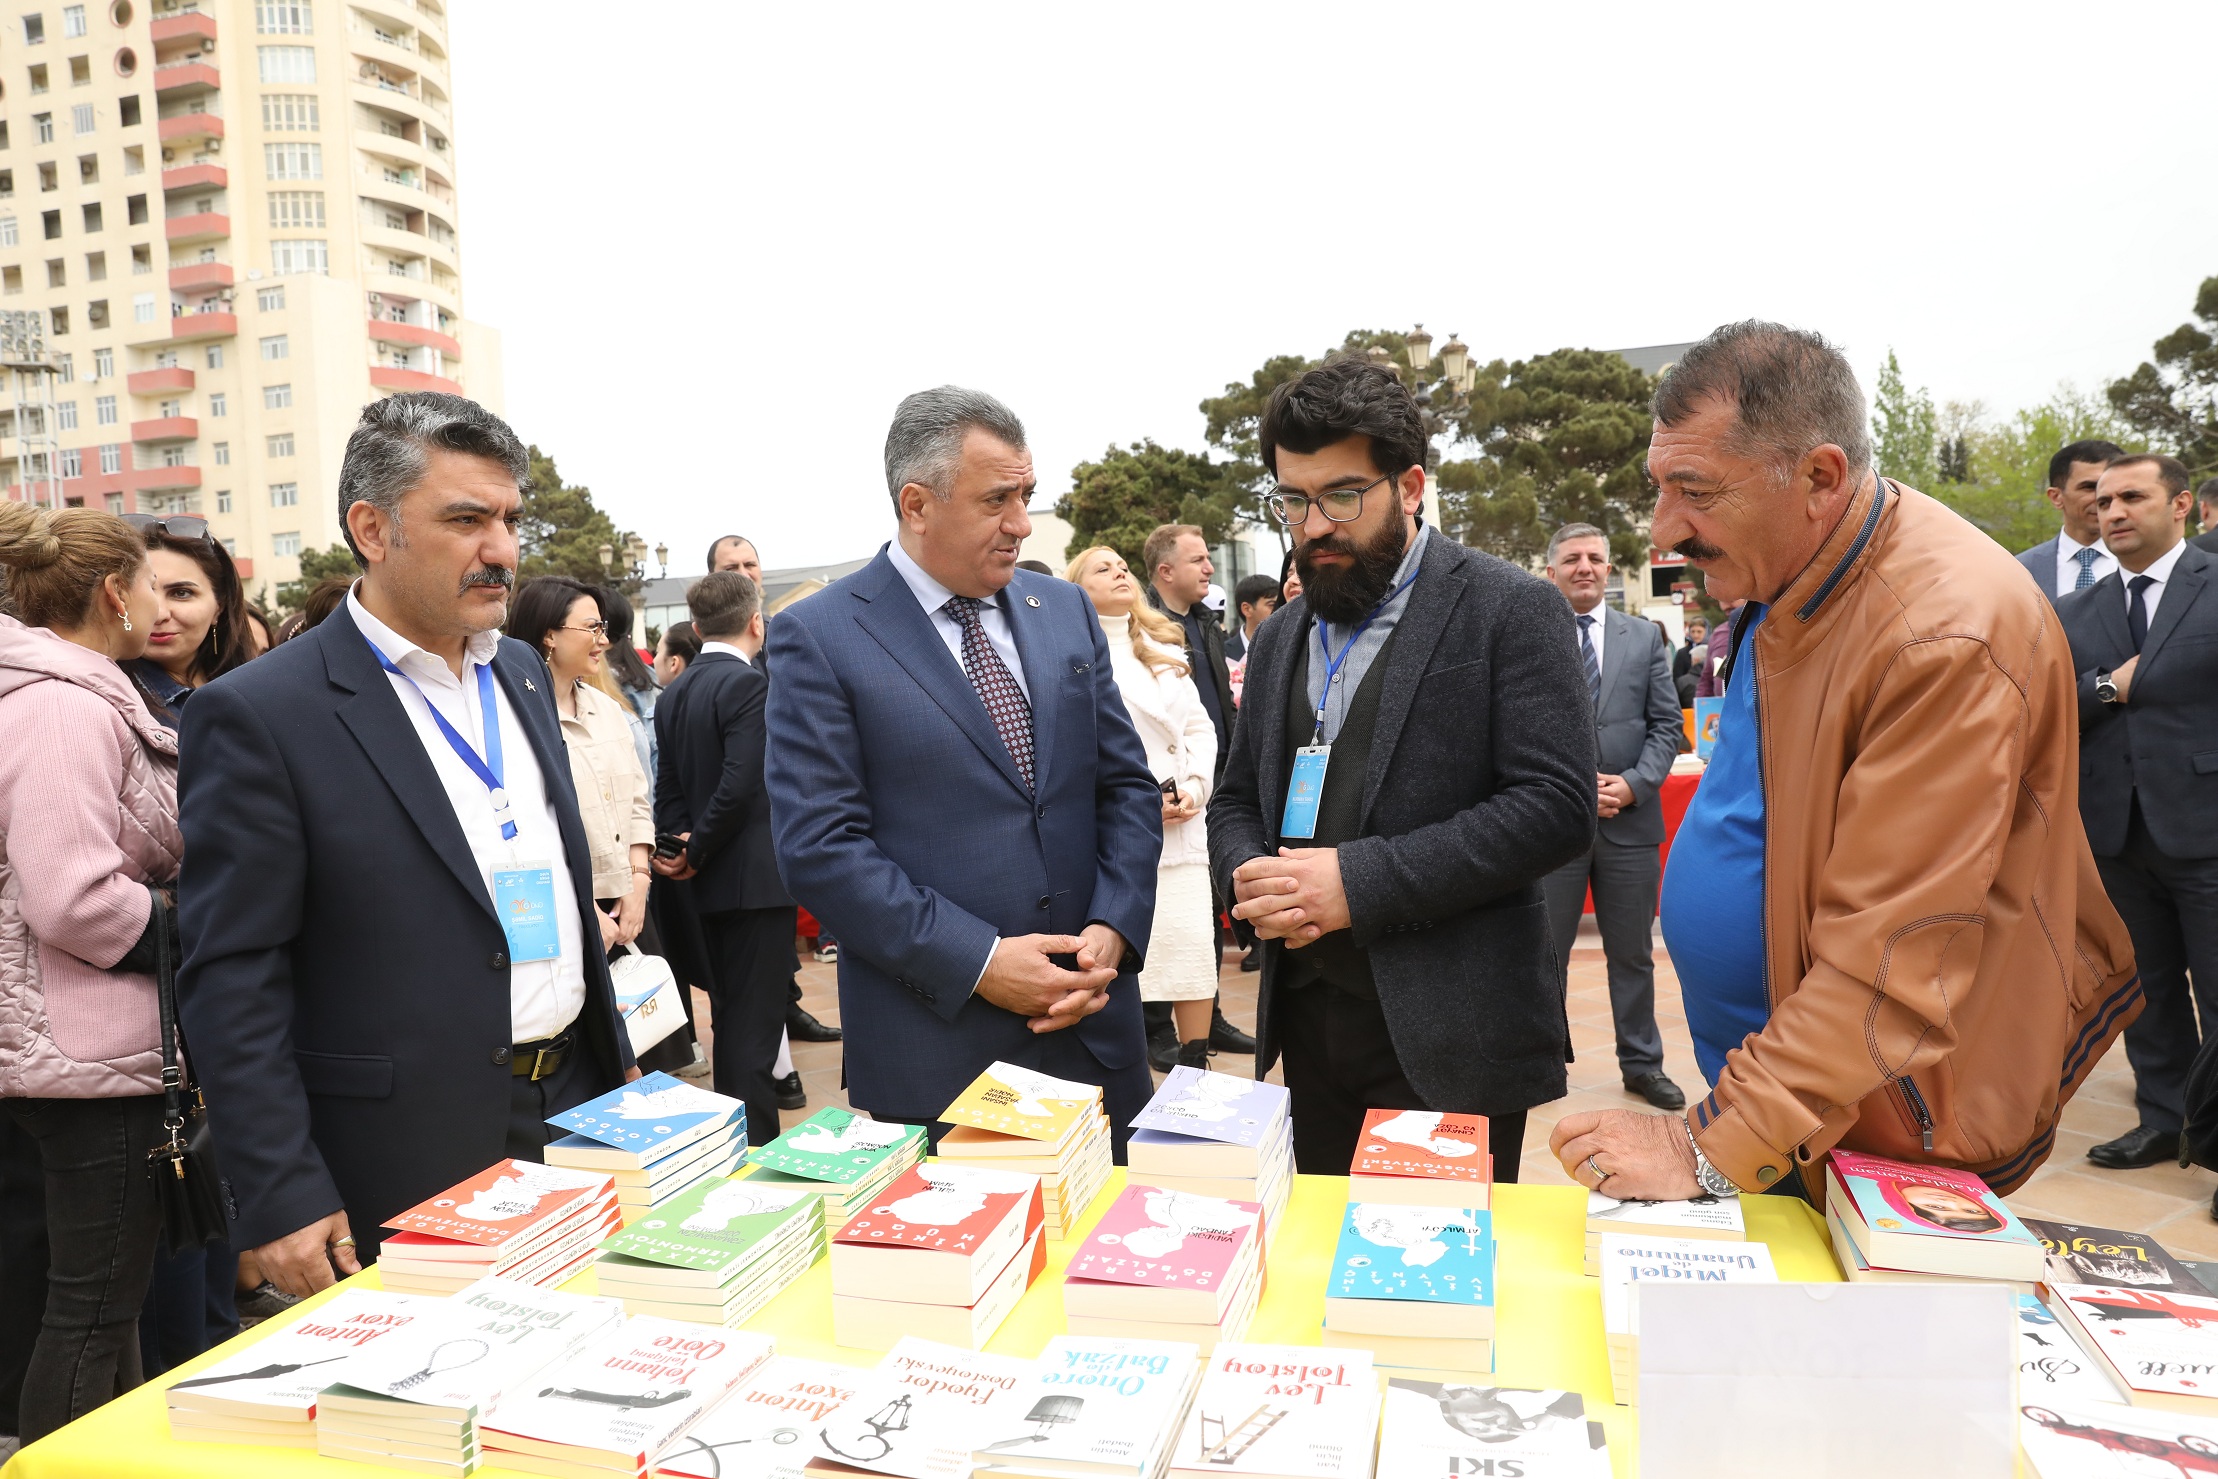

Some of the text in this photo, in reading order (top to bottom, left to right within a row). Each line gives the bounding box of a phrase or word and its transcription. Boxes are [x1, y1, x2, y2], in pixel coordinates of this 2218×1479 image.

[569, 1112, 653, 1144] LONDON
[954, 1107, 1057, 1133] TOLSTOY
[971, 1117, 1030, 1133] LEV
[573, 1122, 625, 1143] CEK
[1361, 1164, 1477, 1179] FYODOR
[1922, 1178, 1984, 1194] Malala
[397, 1218, 500, 1242] FYODOR
[620, 1233, 732, 1259] LERMONTOV
[1082, 1254, 1172, 1272] BALZAK
[1617, 1248, 1757, 1270] Unamuno
[1077, 1263, 1209, 1285] ONORE
[465, 1292, 577, 1330] Tolstoy
[295, 1322, 386, 1347] Anton
[477, 1321, 535, 1345] Lev
[602, 1356, 699, 1385] Yohann
[892, 1356, 1016, 1390] Dostoyevski
[1062, 1350, 1170, 1375] Balzak
[1222, 1357, 1352, 1387] Tolstoy
[896, 1374, 995, 1406] Fyodor
[1041, 1372, 1145, 1396] Onore
[1263, 1383, 1325, 1406] Lev
[744, 1391, 840, 1422] Anton
